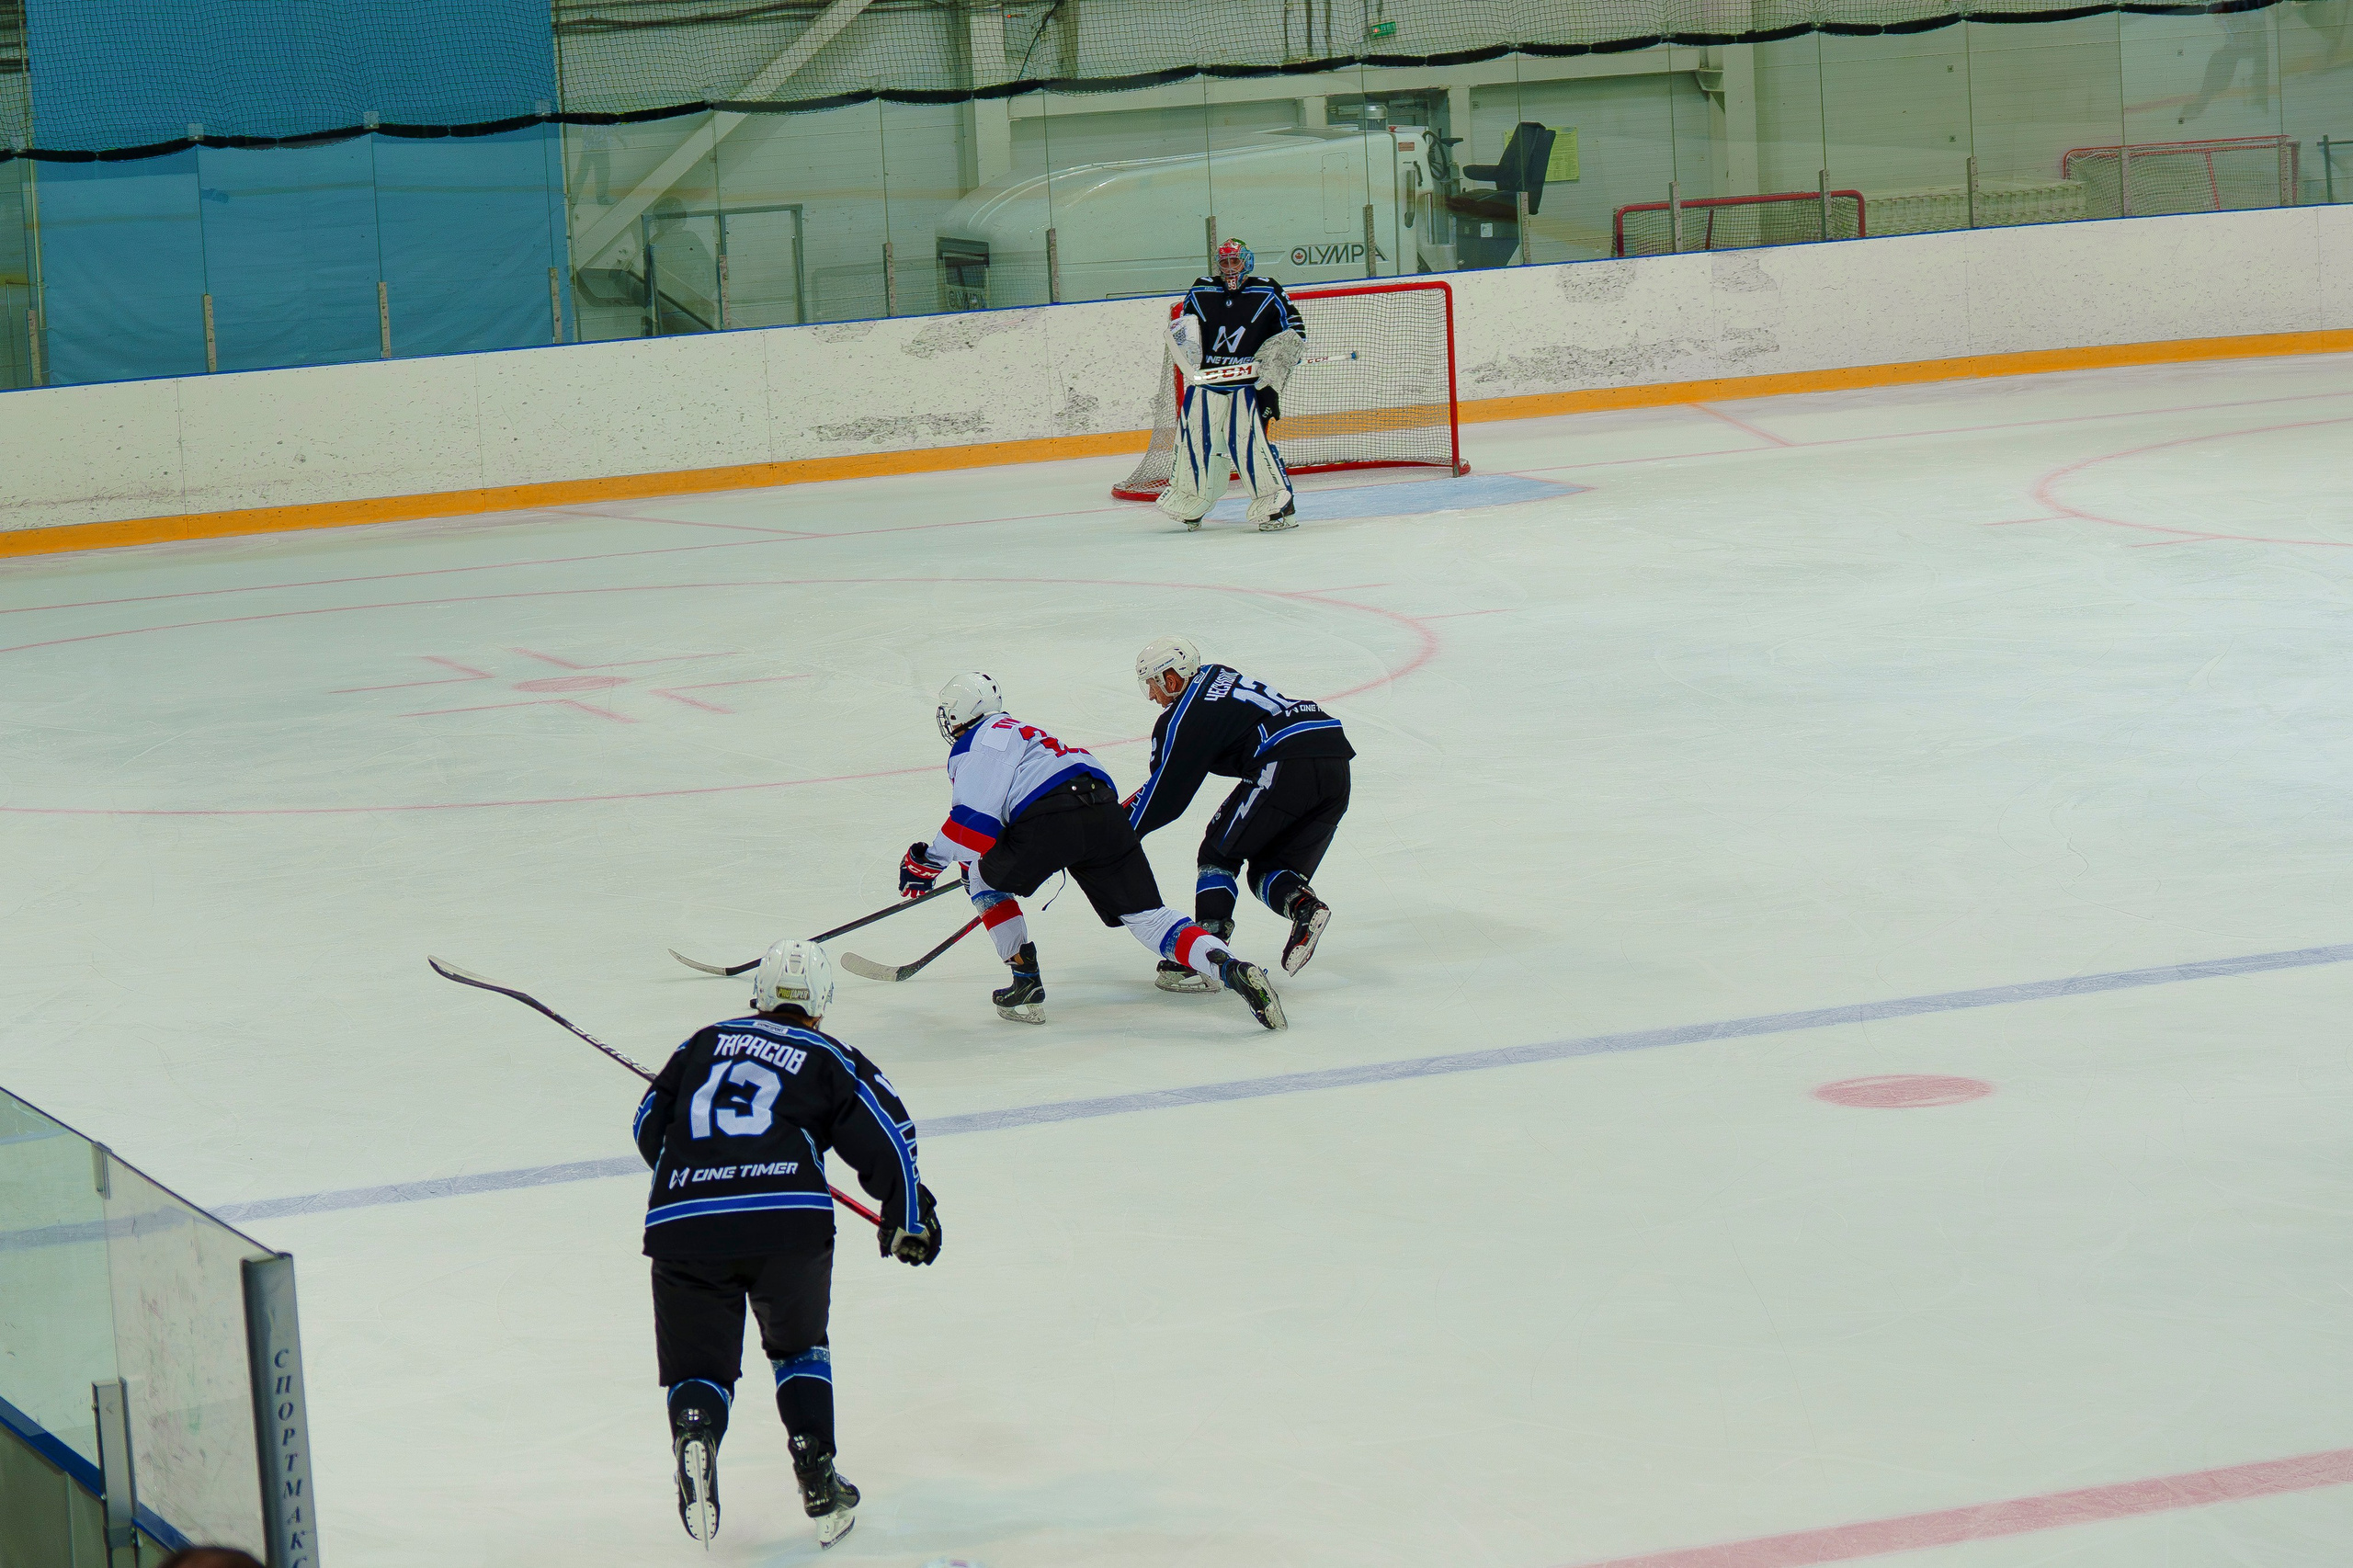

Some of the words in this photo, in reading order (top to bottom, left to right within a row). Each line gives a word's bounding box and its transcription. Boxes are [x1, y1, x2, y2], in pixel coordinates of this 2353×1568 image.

[1290, 243, 1389, 266] OLYMPA
[1204, 365, 1253, 381] CCM
[713, 1033, 808, 1075] ТАРАСОВ
[690, 1060, 782, 1140] 13
[691, 1165, 737, 1182] ONE
[739, 1161, 799, 1177] TIMER
